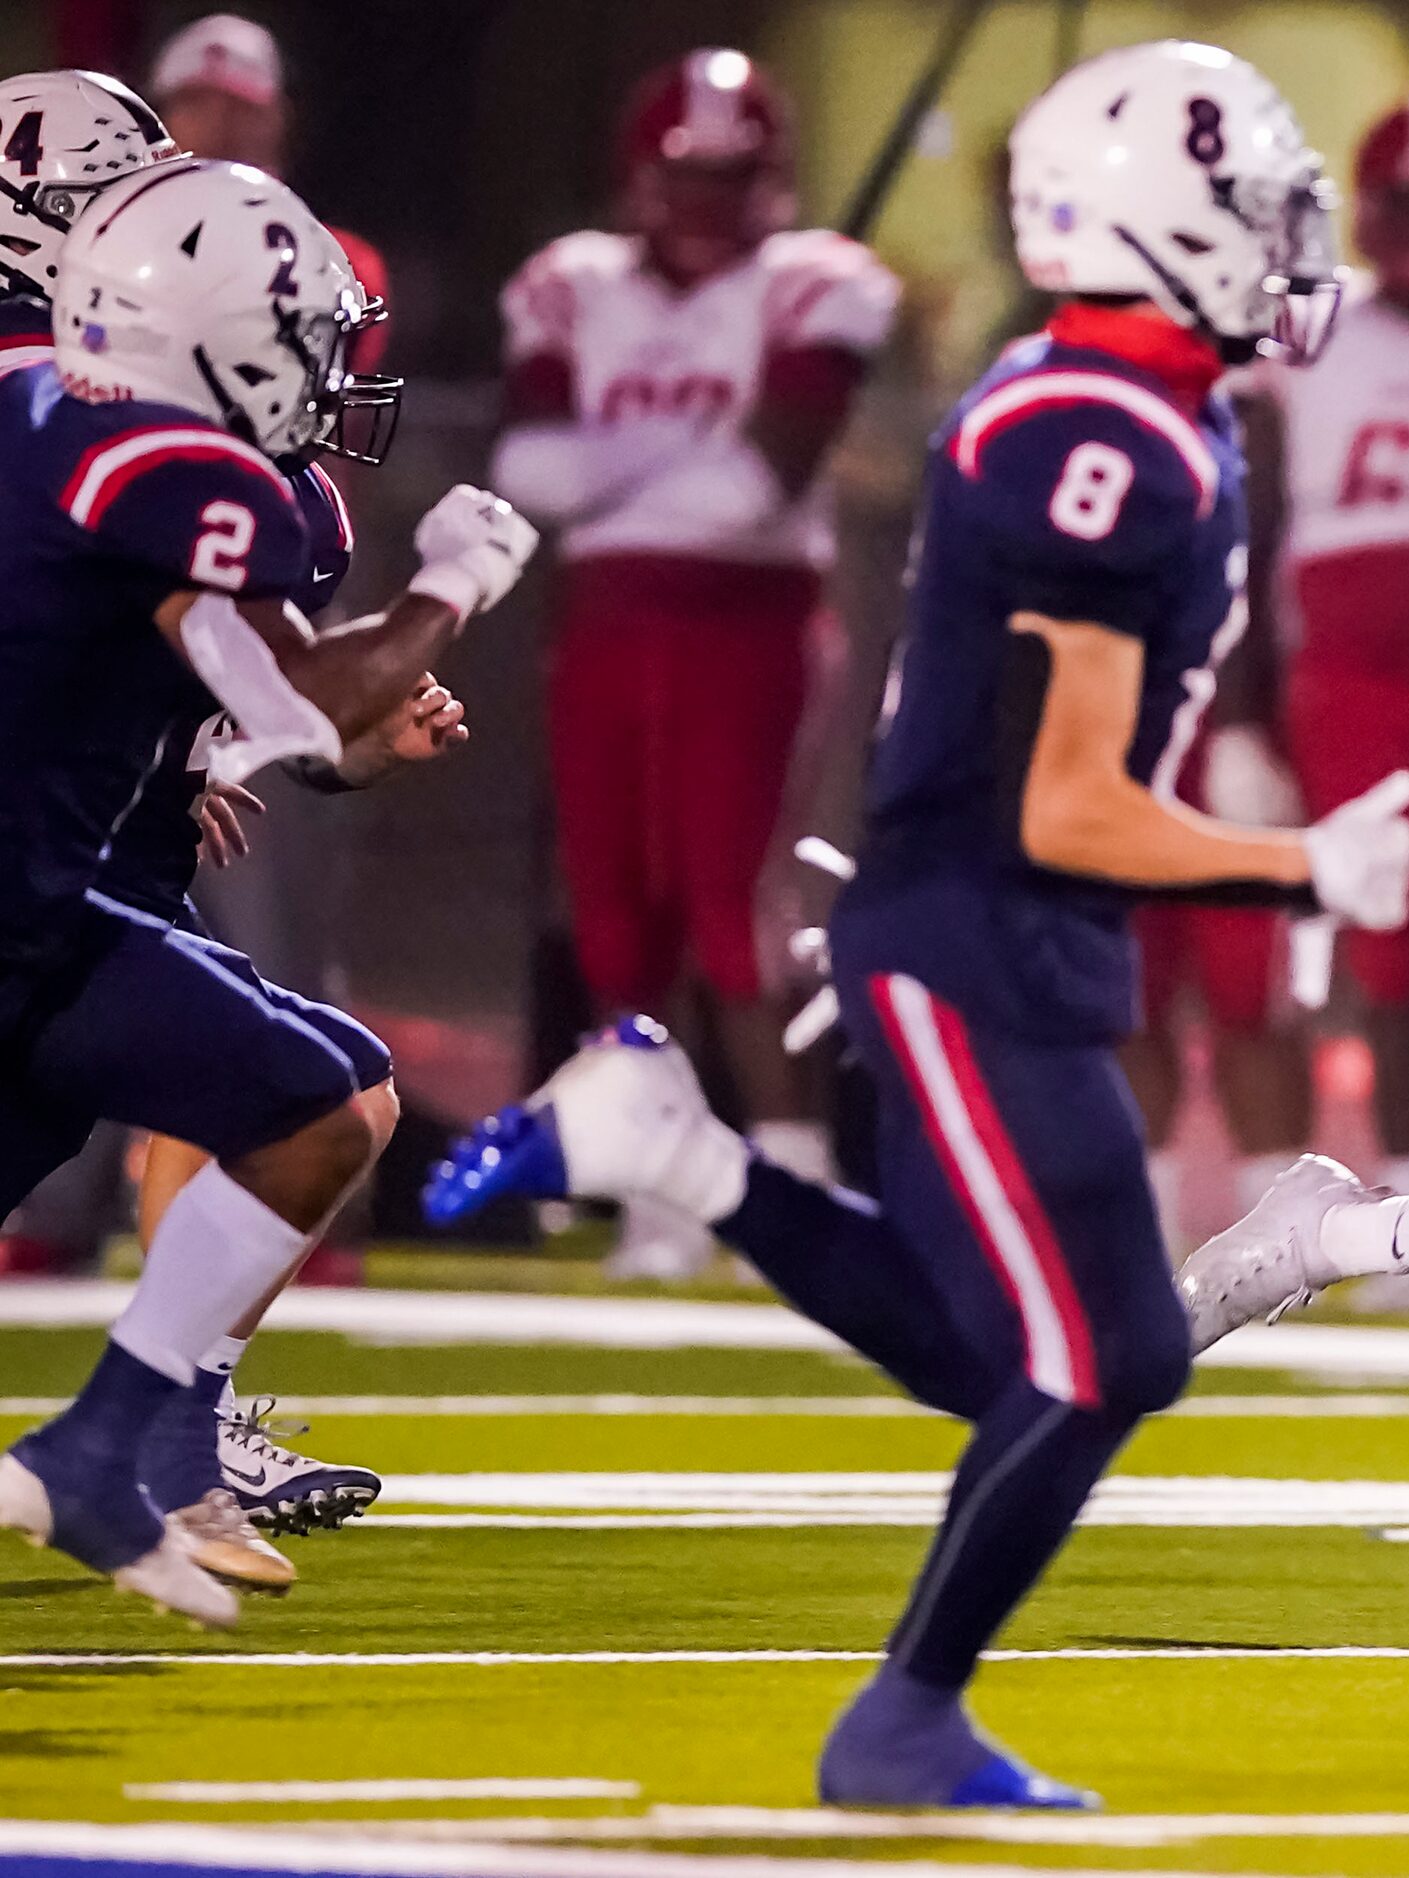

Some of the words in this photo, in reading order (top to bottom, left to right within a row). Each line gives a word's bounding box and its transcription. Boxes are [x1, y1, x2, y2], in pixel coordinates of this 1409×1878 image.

[0, 111, 43, 177] 4
[1187, 97, 1224, 164] 8
[264, 222, 298, 297] 2
[1050, 439, 1135, 540] 8
[190, 500, 256, 591] 2
